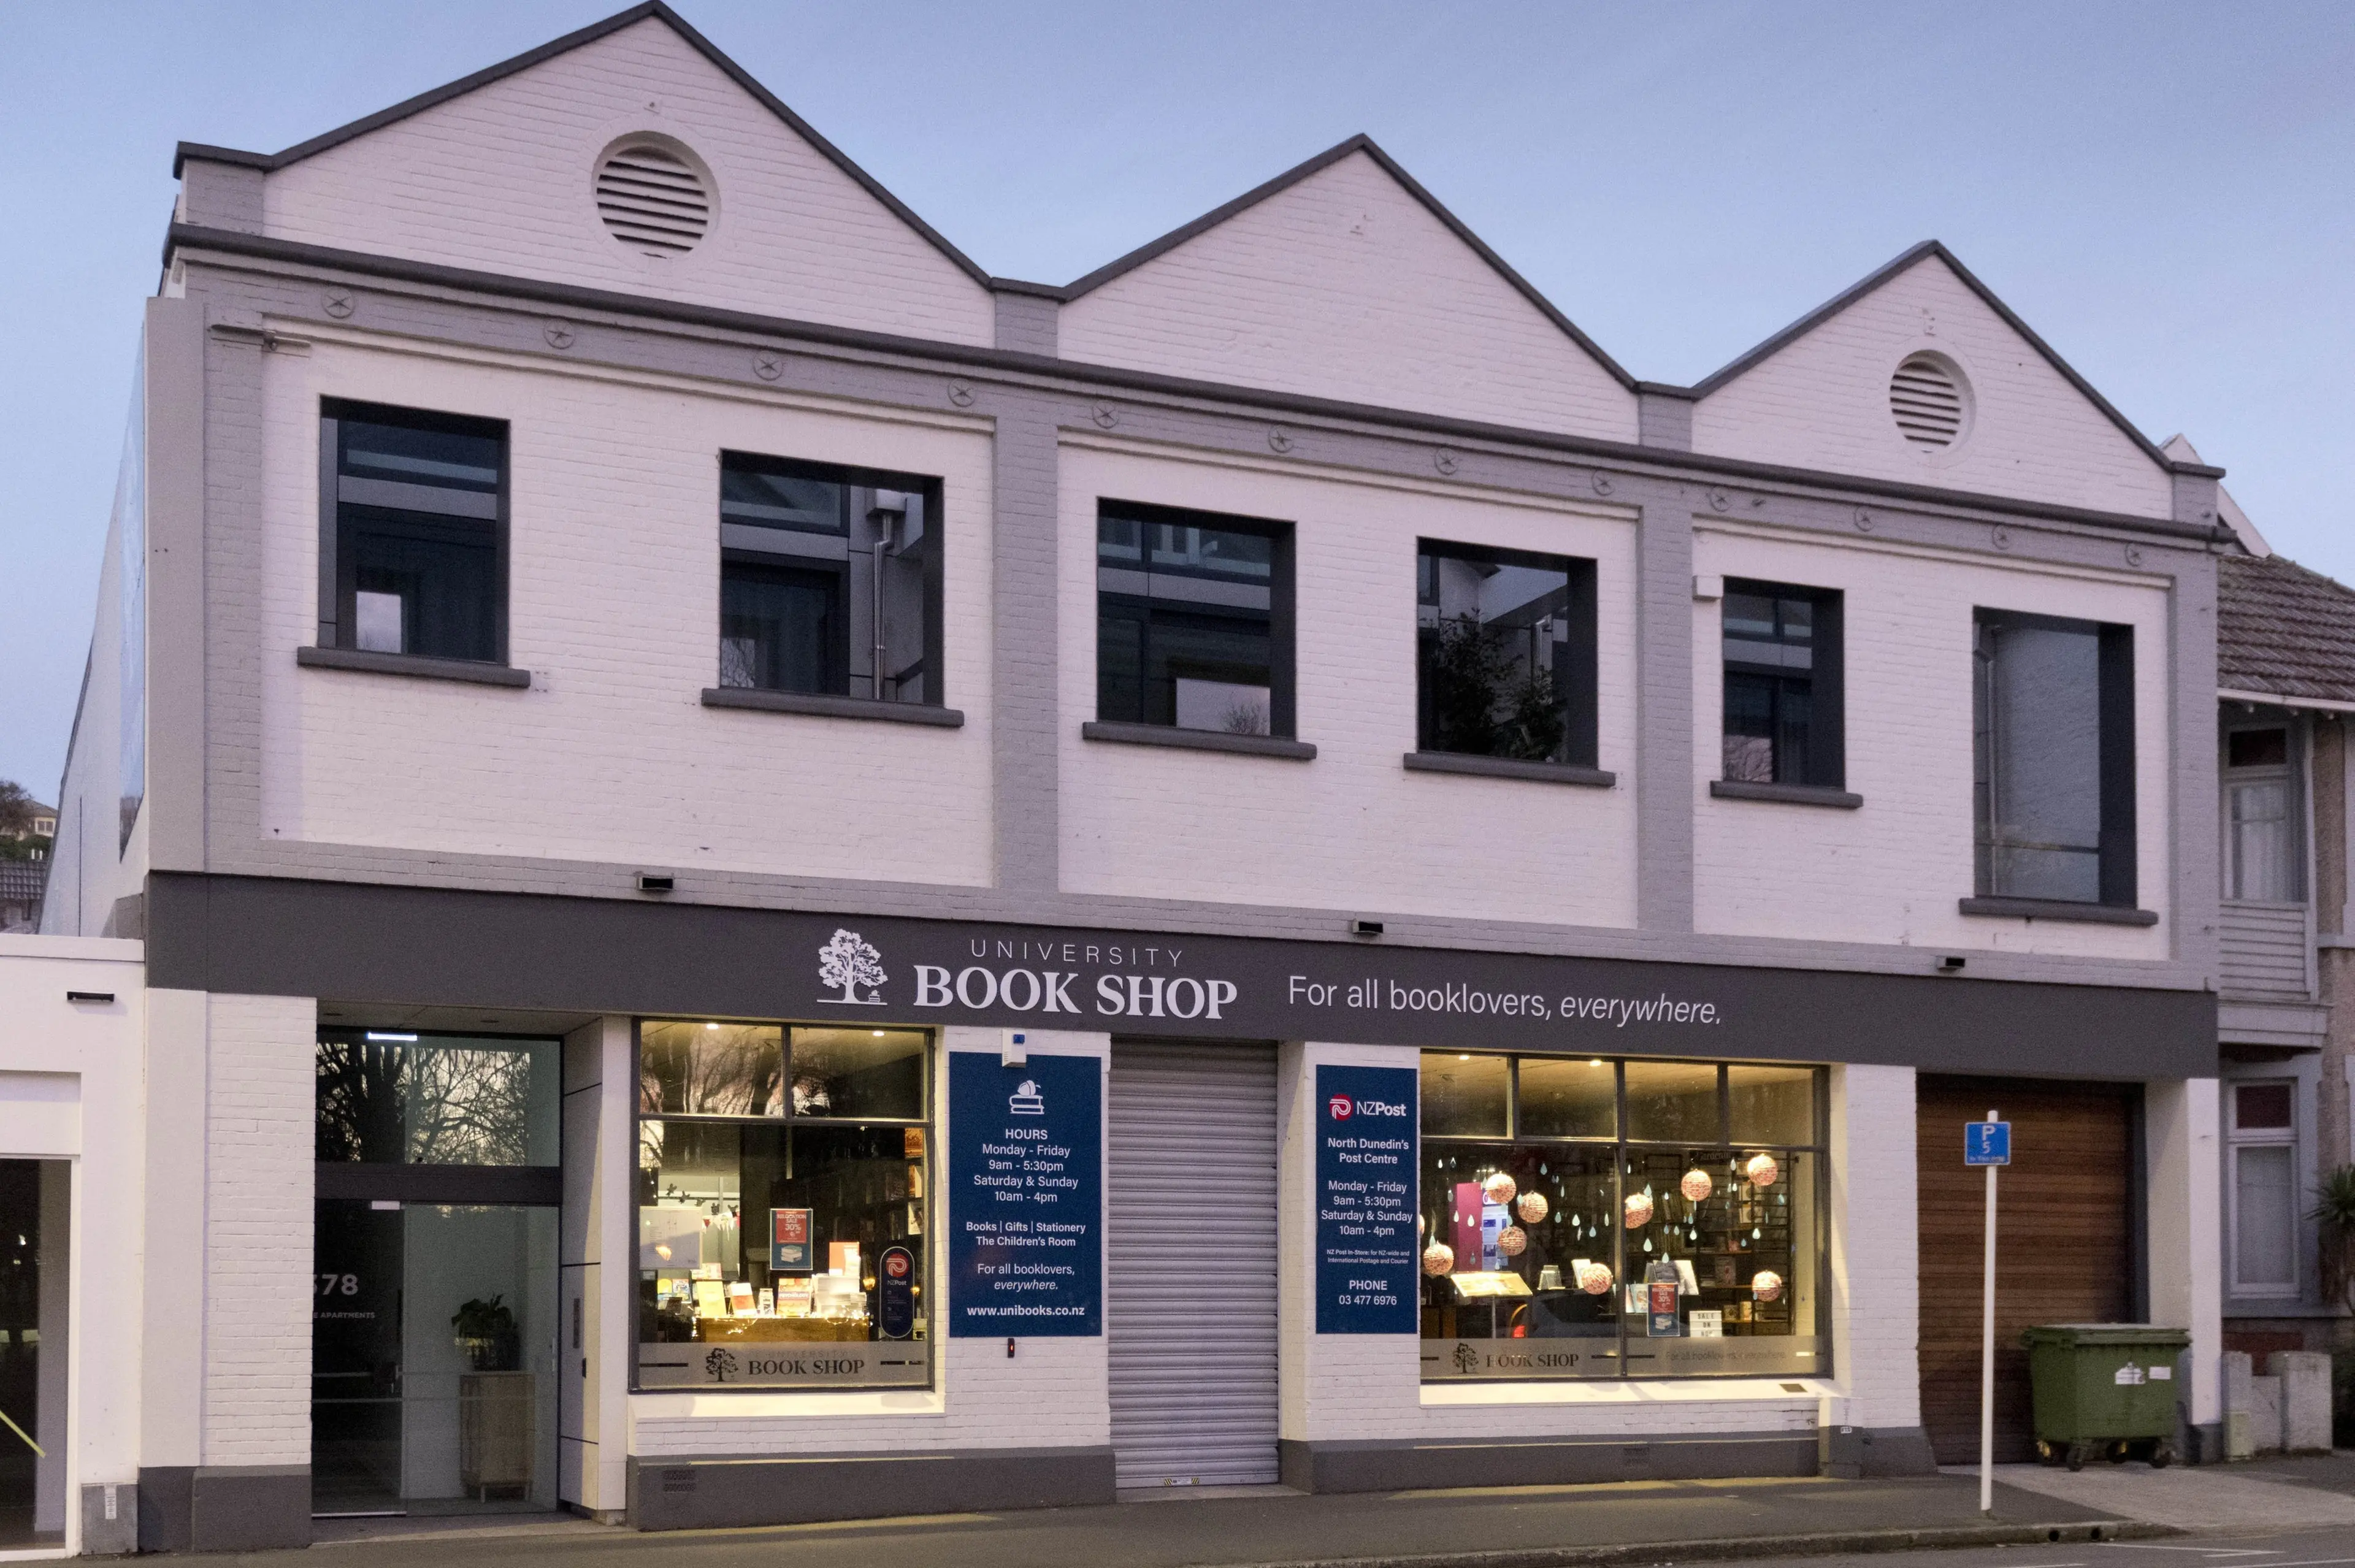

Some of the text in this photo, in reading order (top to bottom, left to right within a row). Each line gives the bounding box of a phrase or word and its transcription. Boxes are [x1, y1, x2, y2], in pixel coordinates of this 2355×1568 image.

[971, 939, 1182, 967] UNIVERSITY
[913, 965, 1238, 1019] BOOK SHOP
[1289, 976, 1721, 1028] For all booklovers, everywhere.
[1357, 1101, 1407, 1117] NZPost
[1005, 1128, 1048, 1141] HOURS
[1982, 1125, 1996, 1141] P
[1328, 1138, 1409, 1150] North Dunedin's
[1982, 1141, 1991, 1153] 5
[982, 1144, 1027, 1158] Monday
[1037, 1145, 1071, 1159] Friday
[1339, 1153, 1398, 1164] Post Centre
[989, 1160, 1013, 1170] 9am
[1023, 1161, 1064, 1174] 5:30pm
[974, 1174, 1079, 1190] Saturday & Sunday
[1328, 1180, 1368, 1193] Monday
[1377, 1181, 1407, 1195] Friday
[995, 1191, 1023, 1201] 10am
[1034, 1192, 1058, 1204] 4pm
[1333, 1196, 1355, 1206] 9am
[1365, 1196, 1401, 1208] 5:30pm
[1321, 1210, 1413, 1224] Saturday & Sunday
[966, 1222, 997, 1231] Books
[1005, 1222, 1028, 1232] Gifts
[1036, 1222, 1086, 1234] Stationery
[1339, 1225, 1365, 1235] 10am
[1373, 1226, 1395, 1237] 4pm
[976, 1236, 1076, 1247] The Children's Room
[978, 1263, 1075, 1276] For all booklovers,
[994, 1279, 1059, 1292] everywhere.
[1349, 1280, 1388, 1291] PHONE
[1339, 1295, 1397, 1306] 03 477 6976
[967, 1304, 1085, 1316] www.unibooks.co.nz
[1537, 1353, 1579, 1367] SHOP
[748, 1359, 865, 1375] BOOK SHOP
